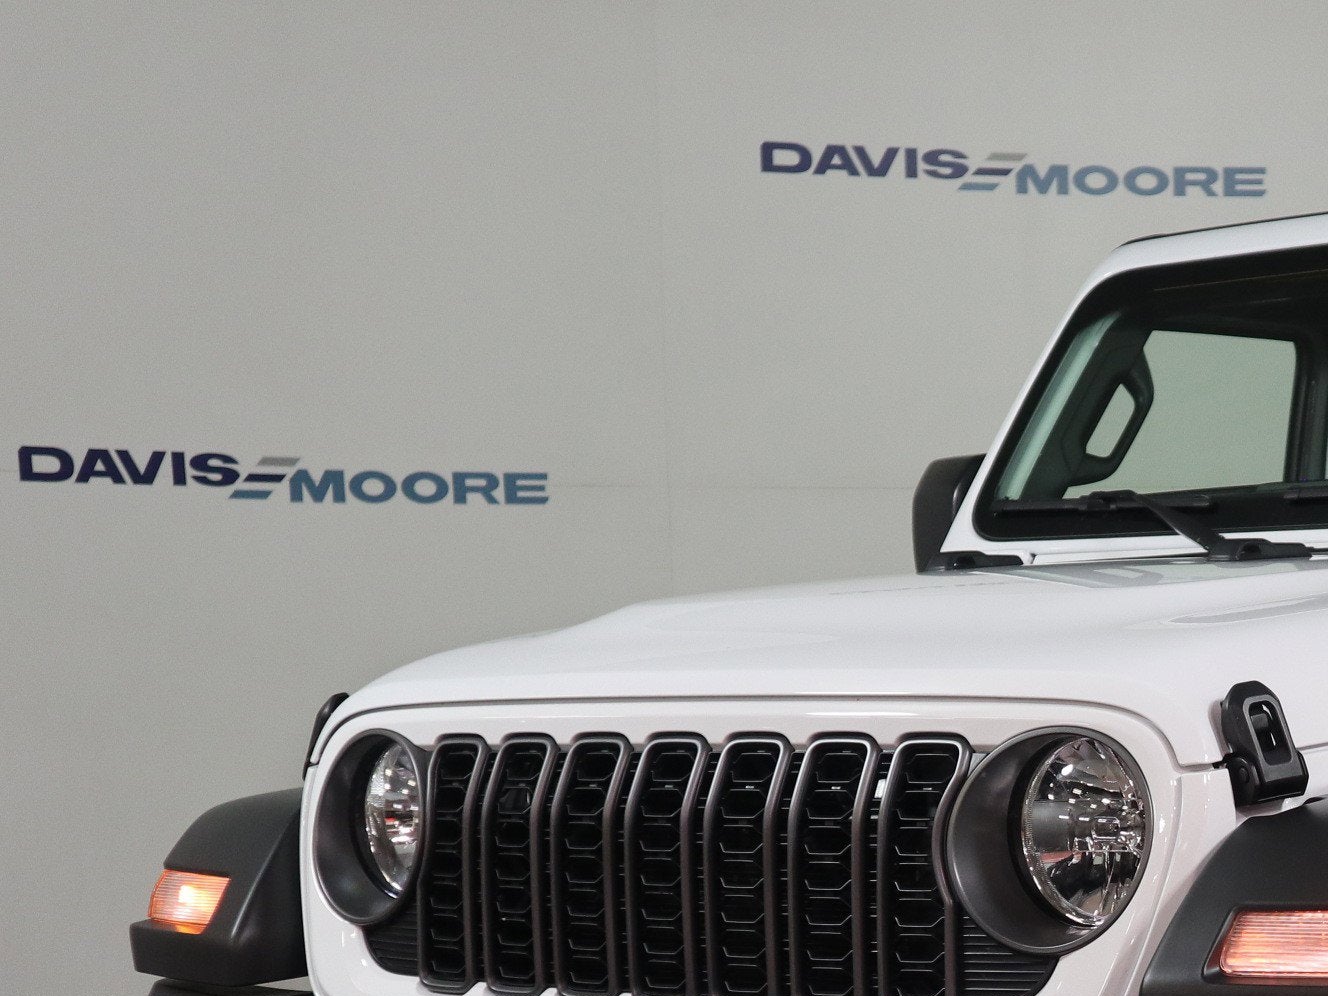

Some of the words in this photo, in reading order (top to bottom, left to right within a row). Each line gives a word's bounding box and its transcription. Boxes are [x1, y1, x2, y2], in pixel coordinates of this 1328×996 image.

[760, 141, 969, 180] DAVIS
[1015, 163, 1267, 198] MOORE
[17, 445, 241, 488] DAVIS
[288, 468, 550, 505] MOORE
